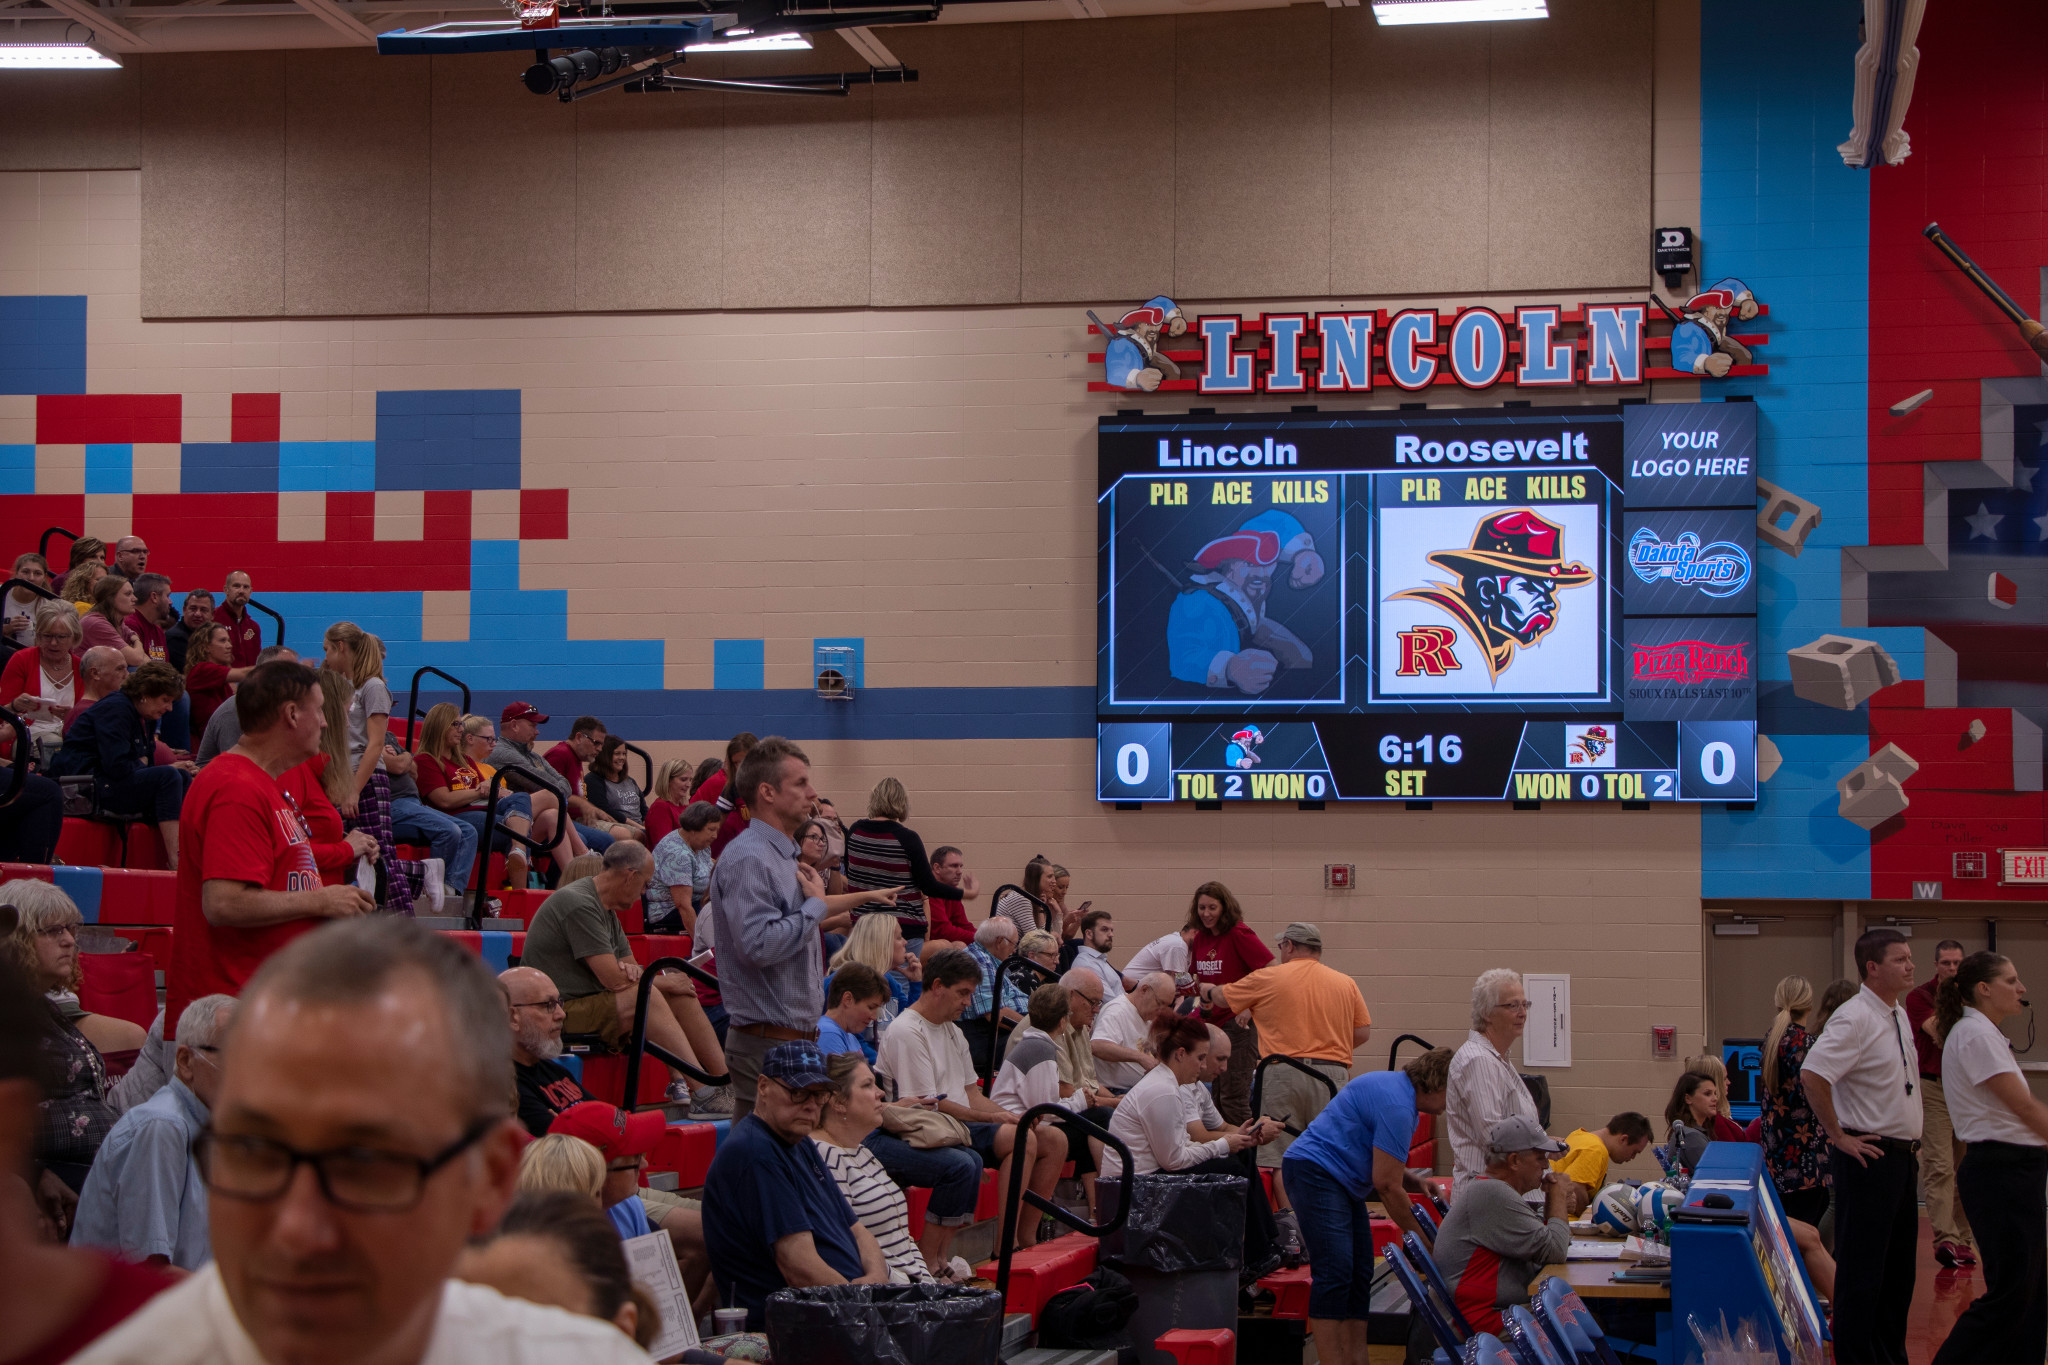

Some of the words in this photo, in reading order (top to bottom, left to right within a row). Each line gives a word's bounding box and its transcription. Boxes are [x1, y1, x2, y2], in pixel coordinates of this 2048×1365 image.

[1199, 303, 1648, 394] LINCOLN
[1158, 437, 1298, 467] Lincoln
[1395, 432, 1589, 463] Roosevelt
[1662, 431, 1719, 450] YOUR
[1631, 459, 1691, 477] LOGO
[1694, 457, 1750, 476] HERE
[1150, 482, 1188, 506] PLR
[1211, 481, 1252, 505] ACE
[1271, 479, 1329, 504] KILLS
[1401, 478, 1441, 502] PLR
[1464, 476, 1507, 501] ACE
[1526, 475, 1586, 500] KILLS
[1636, 543, 1698, 564] Dakota
[1674, 558, 1735, 583] Sports
[1633, 651, 1685, 675] Pizza
[1688, 646, 1748, 674] Ranch
[1629, 688, 1662, 699] SIOUX
[1664, 688, 1698, 699] FALLS
[1701, 688, 1729, 699] EAST
[1379, 734, 1463, 764] 6:16
[1116, 743, 1149, 786] 0
[1700, 741, 1736, 785] 0
[1178, 774, 1218, 799] TOL
[1224, 775, 1243, 797] 2
[1250, 774, 1305, 799] WON
[1307, 775, 1325, 797] 0
[1385, 769, 1427, 796] SET
[1515, 773, 1571, 799] WON
[1580, 774, 1599, 797] 0
[1603, 773, 1645, 799] TOL
[1653, 774, 1673, 797] 2
[1930, 820, 1967, 830] Dave
[1945, 831, 1983, 842] Fuller
[2014, 856, 2047, 878] EXIT
[1917, 883, 1937, 898] W
